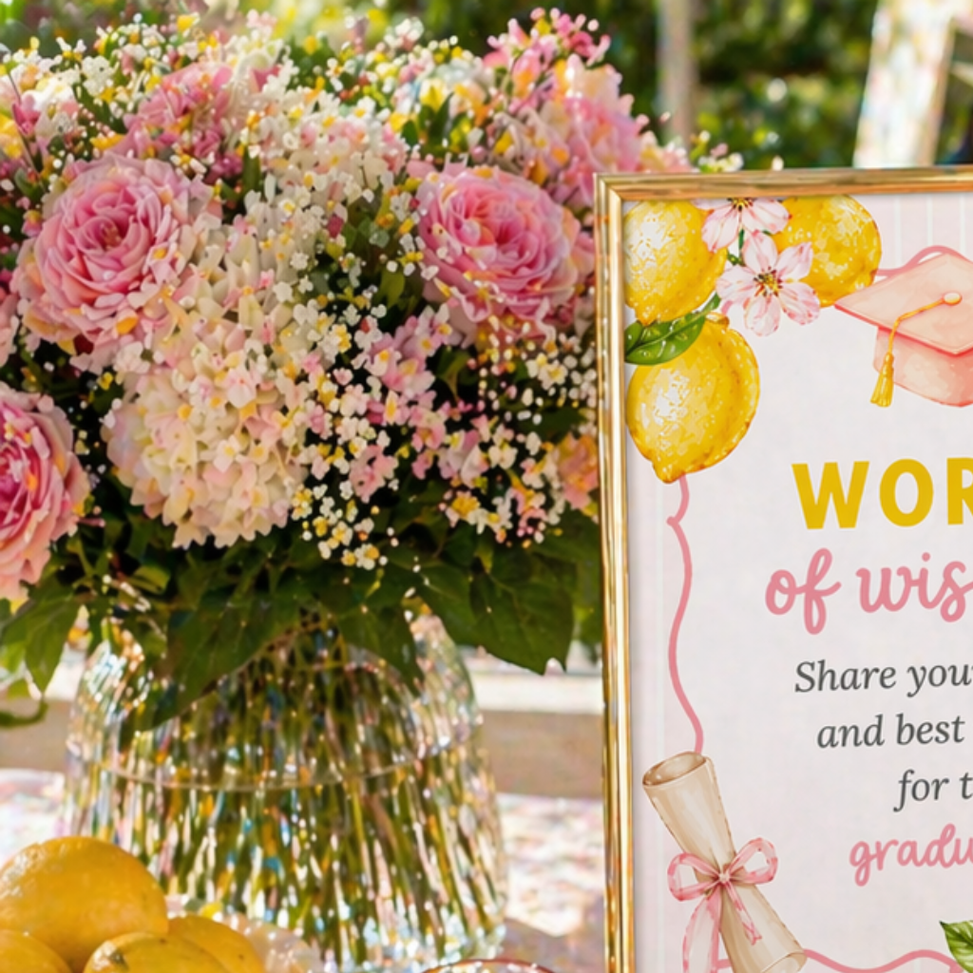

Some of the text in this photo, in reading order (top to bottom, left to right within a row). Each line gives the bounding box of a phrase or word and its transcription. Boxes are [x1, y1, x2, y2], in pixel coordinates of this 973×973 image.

[765, 548, 841, 635] of
[795, 660, 896, 692] Share
[818, 714, 884, 748] and
[897, 713, 965, 745] best
[893, 769, 949, 812] for
